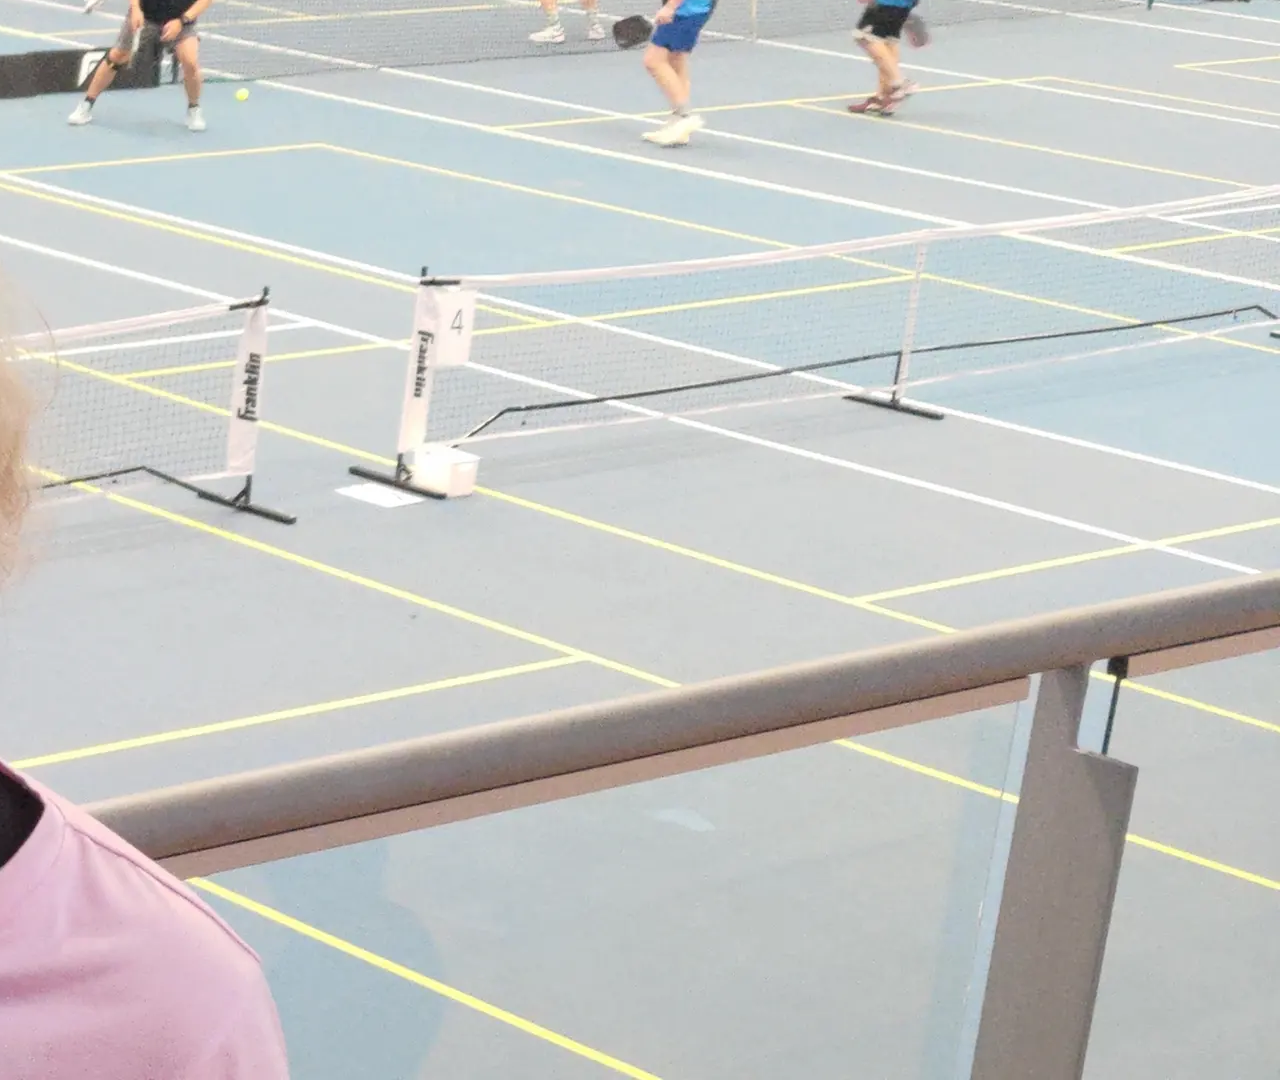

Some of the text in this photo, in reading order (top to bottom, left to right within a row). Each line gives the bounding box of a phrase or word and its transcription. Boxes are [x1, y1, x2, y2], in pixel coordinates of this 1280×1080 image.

[450, 308, 464, 336] 4
[236, 351, 261, 422] Franklin
[413, 329, 435, 398] Franklin
